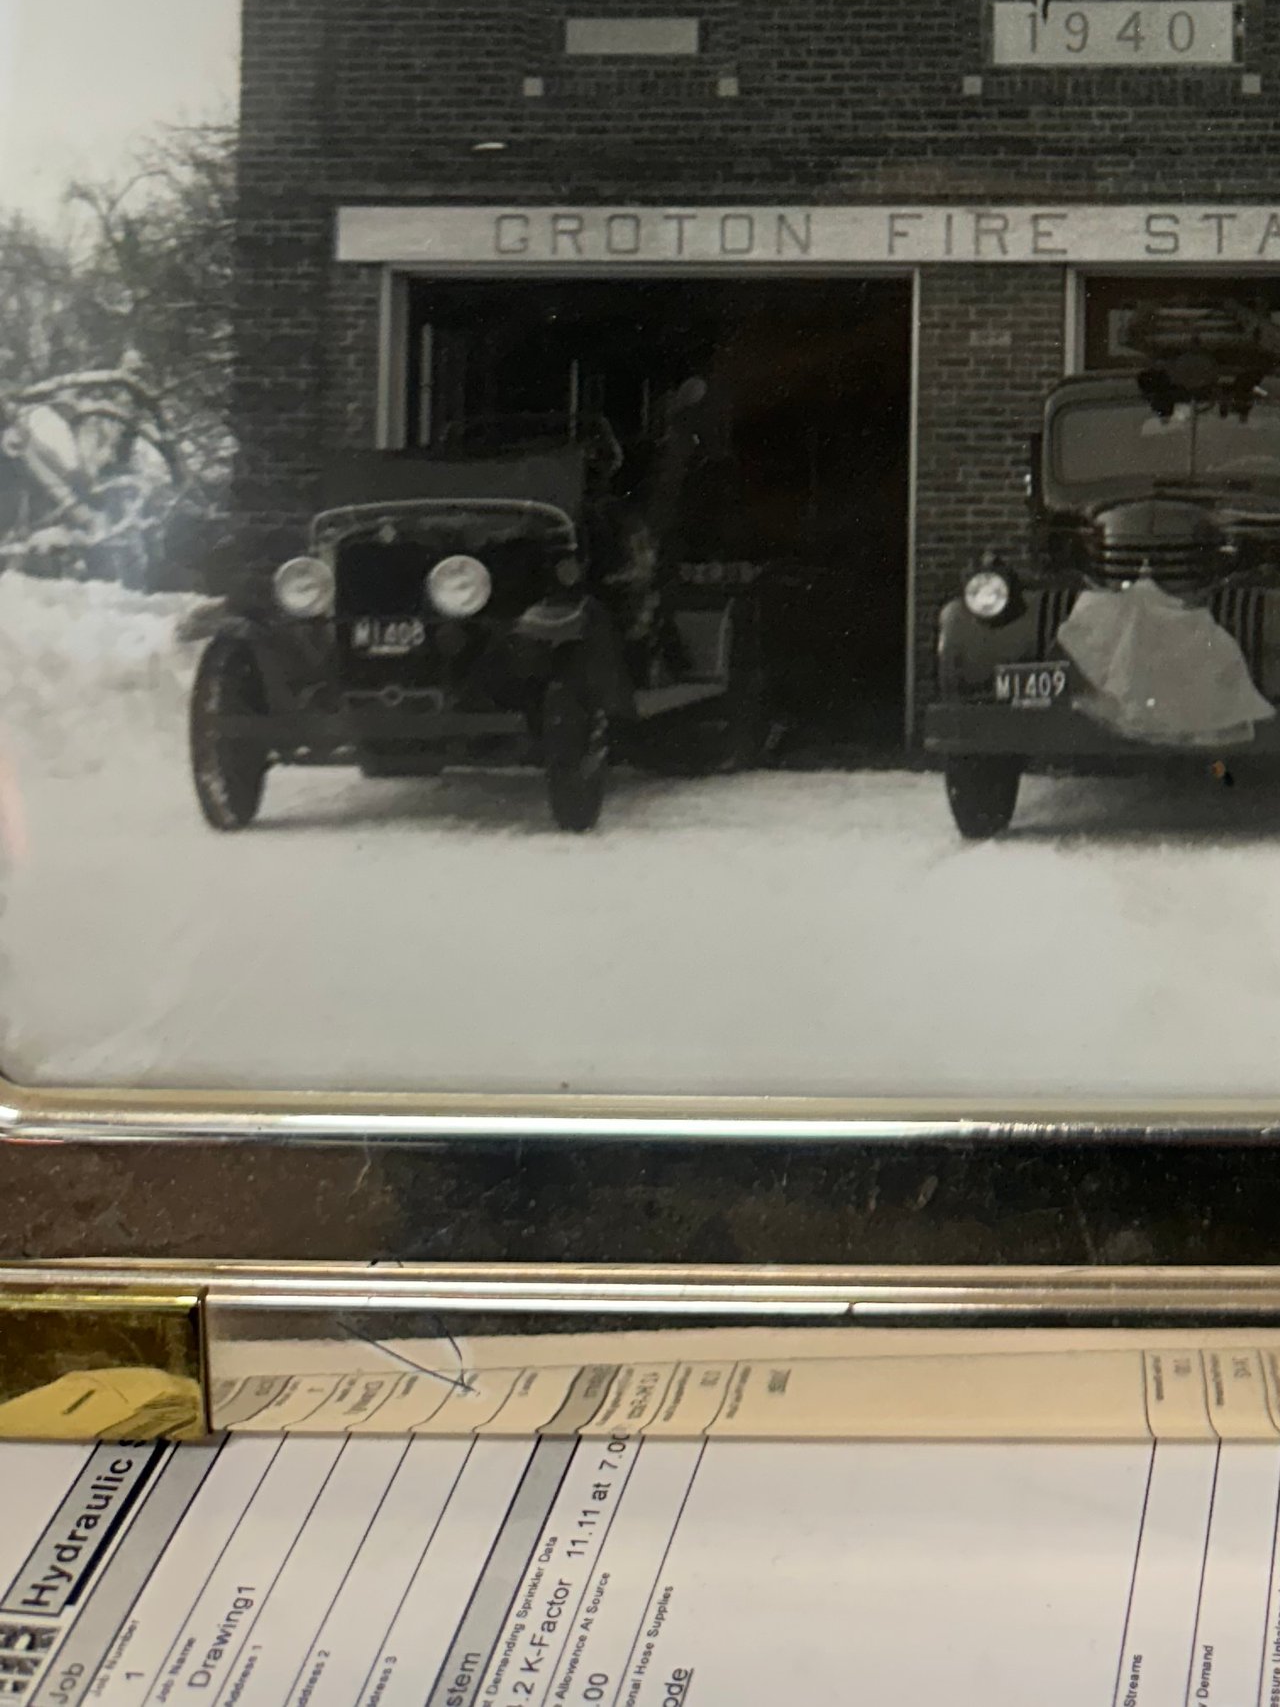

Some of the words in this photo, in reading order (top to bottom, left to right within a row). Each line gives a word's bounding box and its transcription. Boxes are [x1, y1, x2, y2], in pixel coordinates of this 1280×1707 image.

[1026, 10, 1195, 53] 1940
[494, 213, 812, 255] GROTON
[888, 212, 1068, 255] FIRE
[21, 1458, 133, 1607] Hydraulic
[520, 1578, 573, 1673] K-Factor
[567, 1508, 601, 1558] 11.11
[592, 1482, 612, 1501] at
[105, 1619, 141, 1670] Number
[187, 1585, 256, 1689] Drawing1
[486, 1622, 526, 1696] Demanding
[516, 1566, 545, 1618] Sprinkler
[538, 1536, 558, 1563] Data
[555, 1634, 587, 1700] Allowance
[580, 1616, 594, 1632] At
[589, 1572, 611, 1615] Source
[633, 1642, 655, 1676] Hose
[647, 1585, 674, 1638] Supplies
[49, 1662, 85, 1704] Job
[126, 1670, 144, 1681] 1
[156, 1677, 175, 1703] Job
[169, 1636, 197, 1676] Name
[1124, 1654, 1143, 1707] Streams
[1196, 1644, 1214, 1699] Demand
